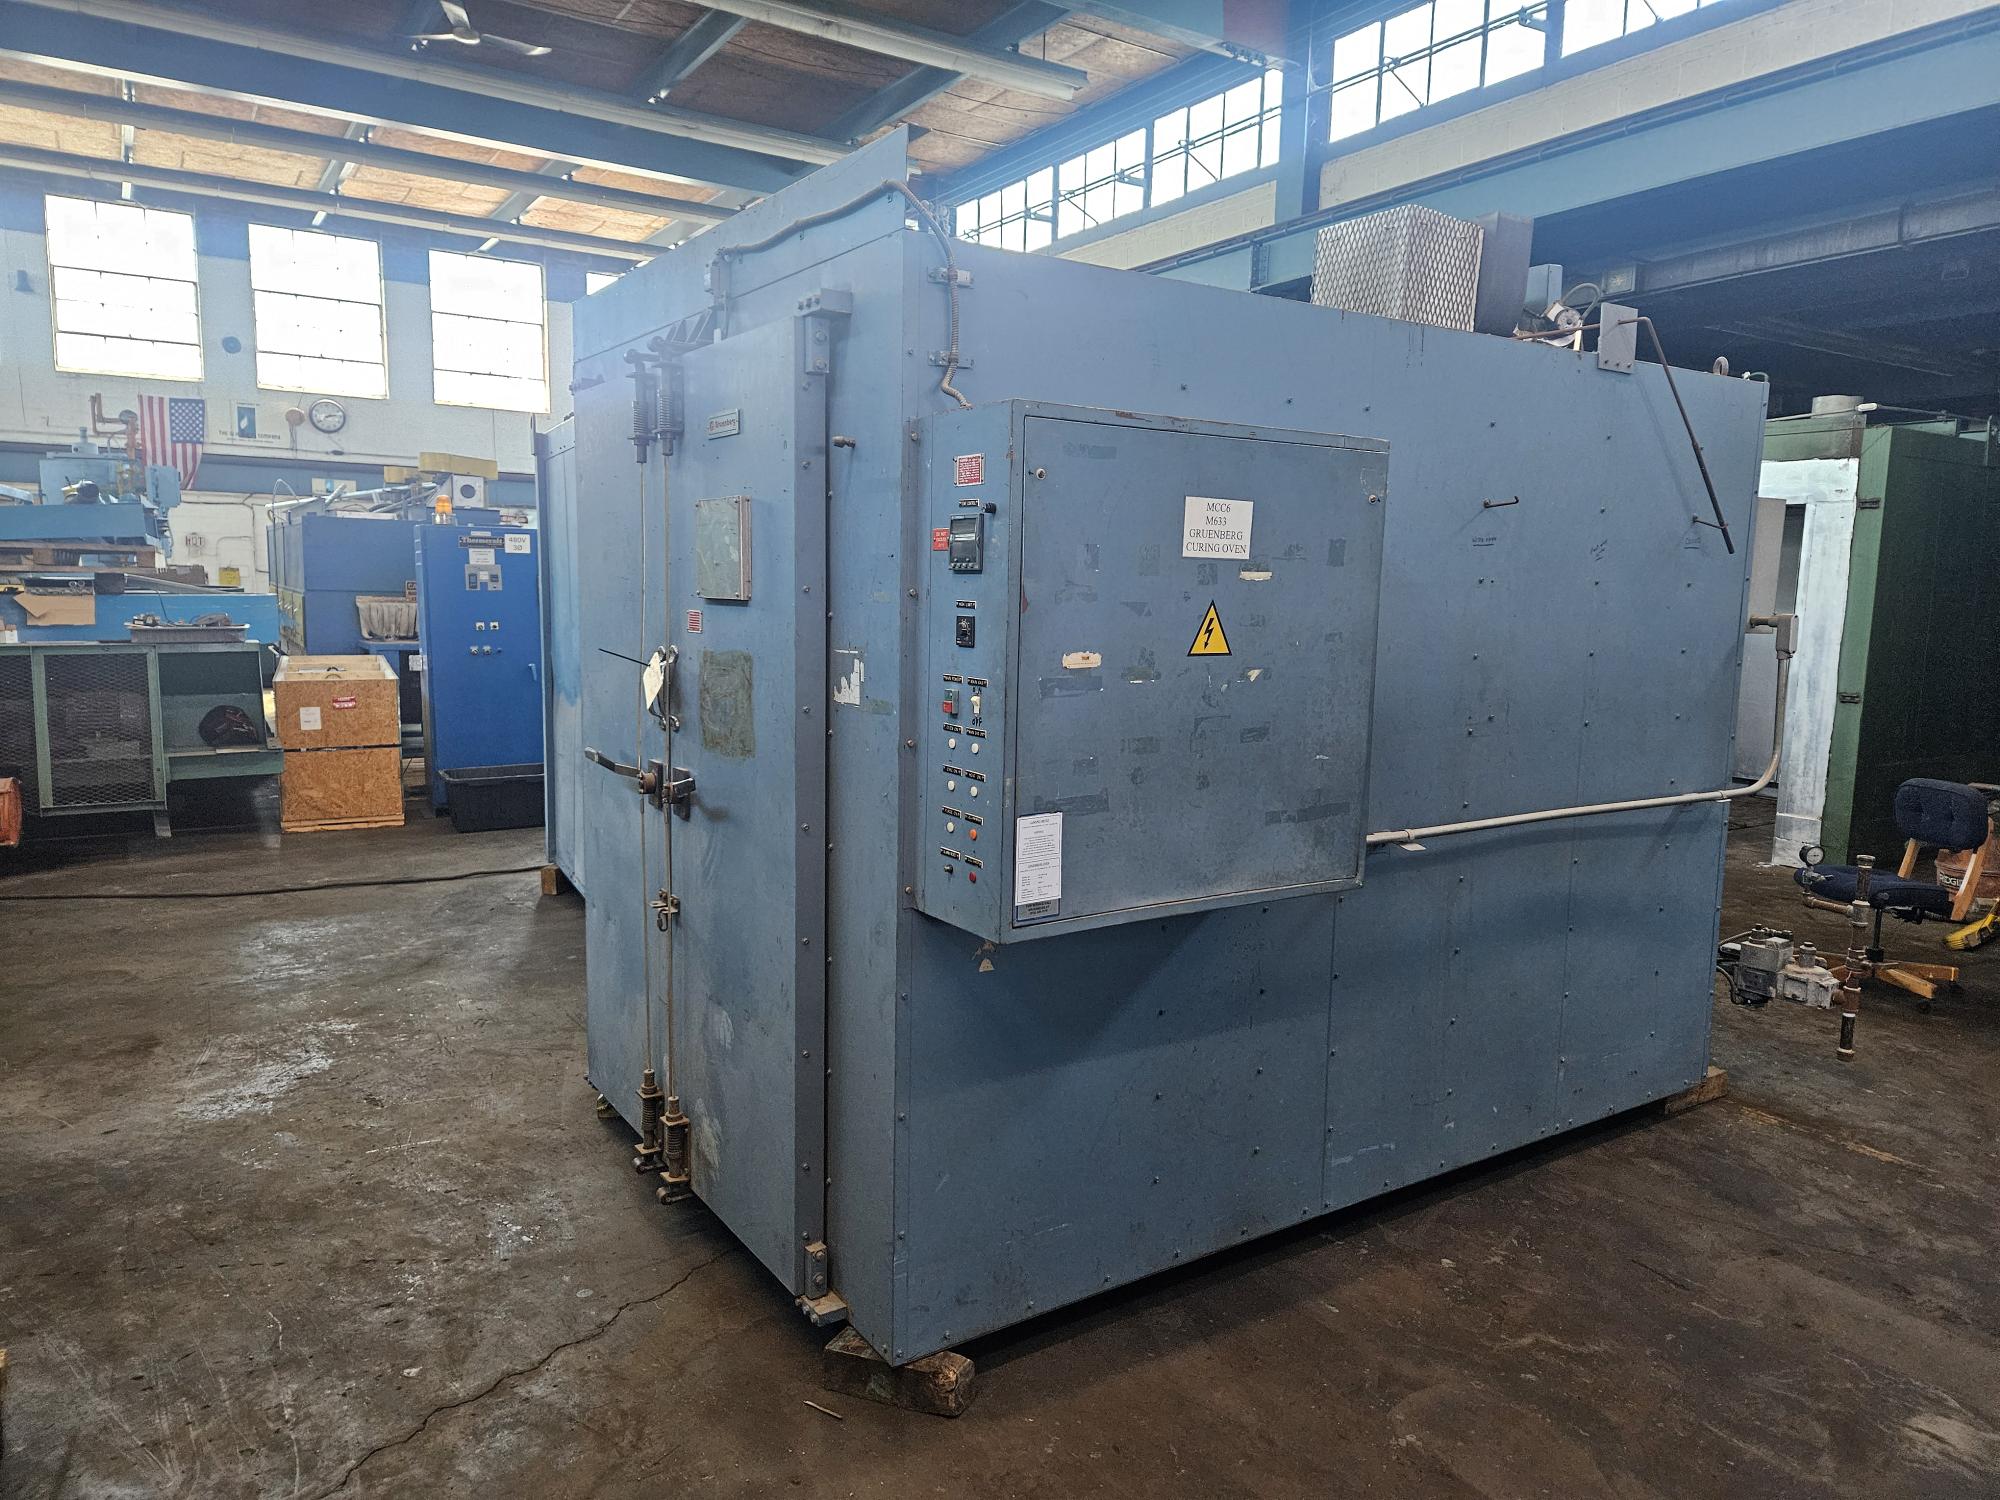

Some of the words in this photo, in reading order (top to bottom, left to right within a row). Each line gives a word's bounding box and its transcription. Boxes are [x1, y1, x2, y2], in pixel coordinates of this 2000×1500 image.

[1206, 502, 1231, 513] MCC6
[1205, 516, 1227, 526] M633
[508, 536, 527, 544] 480V
[1189, 529, 1243, 541] GRUENBERG
[185, 536, 203, 546] HOT
[1186, 542, 1220, 553] CURING
[1222, 544, 1247, 554] OVEN
